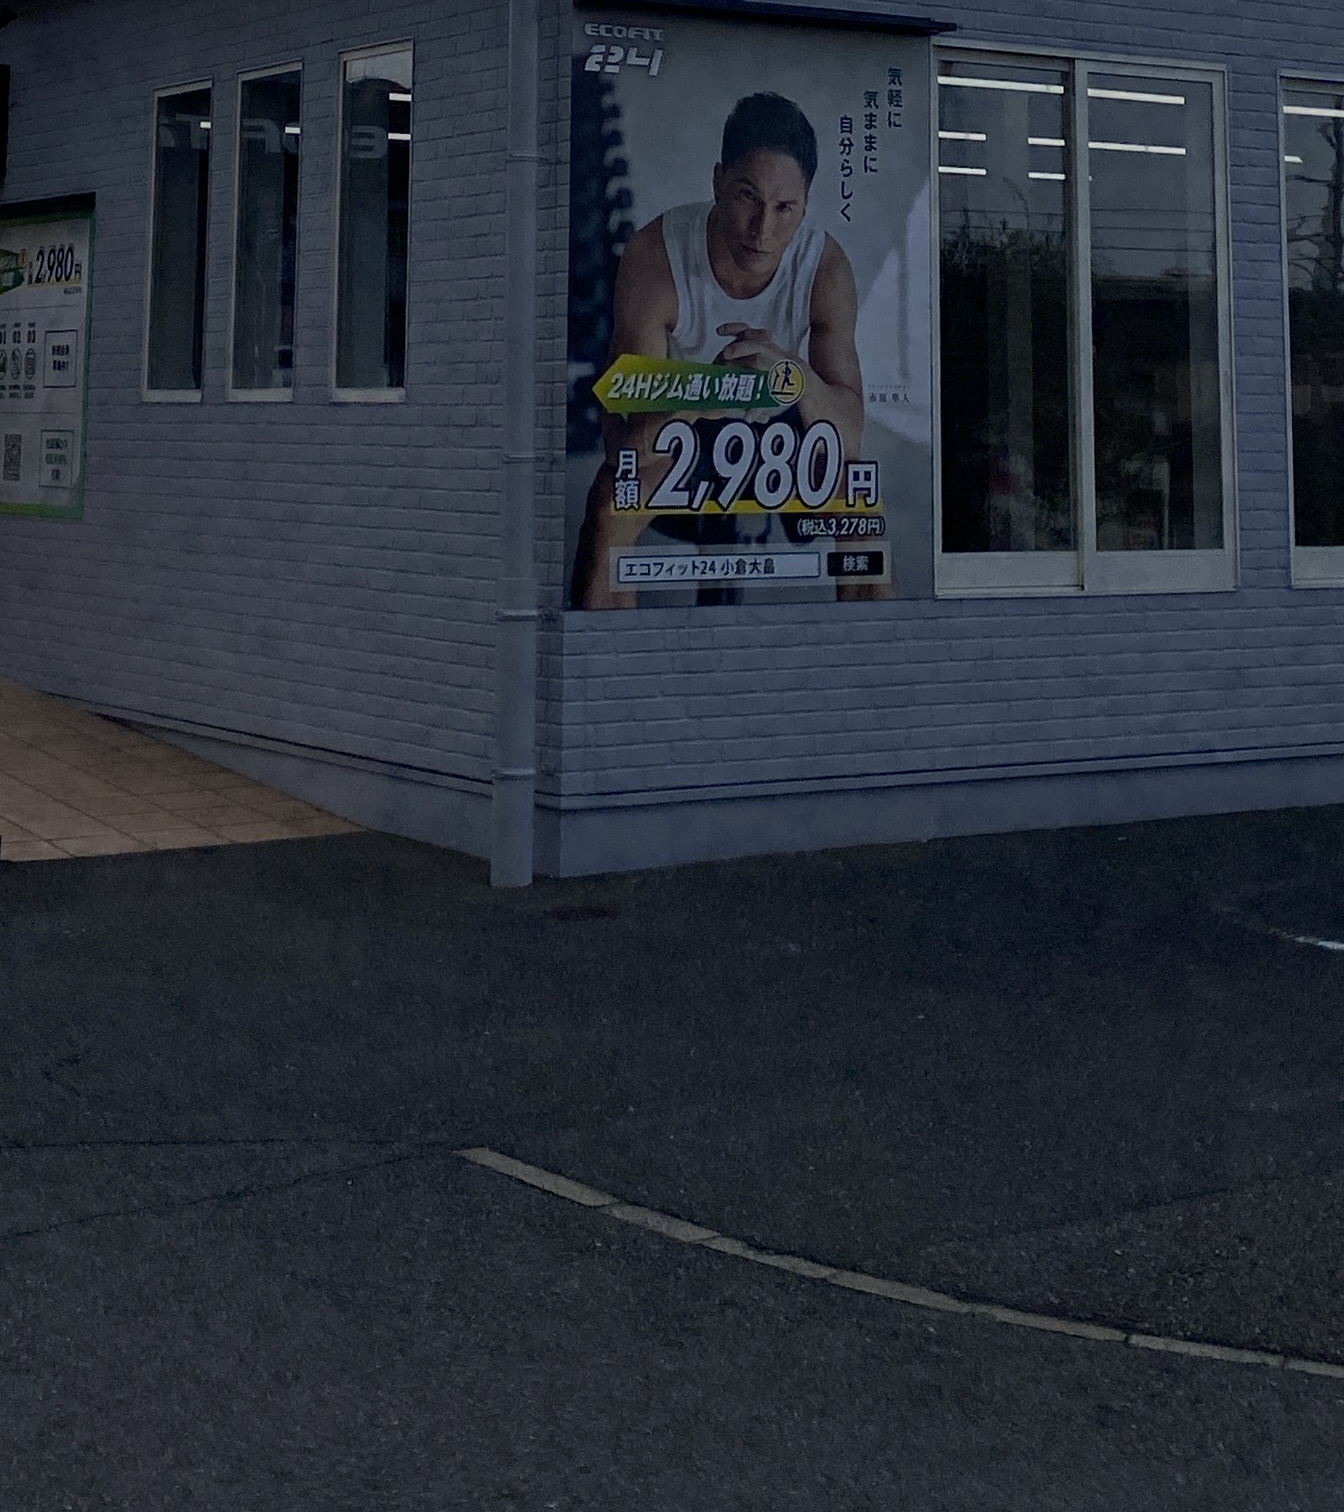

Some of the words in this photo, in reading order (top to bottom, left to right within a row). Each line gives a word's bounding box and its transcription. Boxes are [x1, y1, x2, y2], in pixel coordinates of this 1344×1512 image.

[584, 23, 664, 41] ECOFIT
[584, 44, 663, 76] 24
[887, 66, 903, 128] 気軽に
[863, 90, 879, 173] 気ままに
[838, 115, 854, 223] 自分らしく
[614, 449, 641, 511] 月額
[842, 555, 869, 572] 検索
